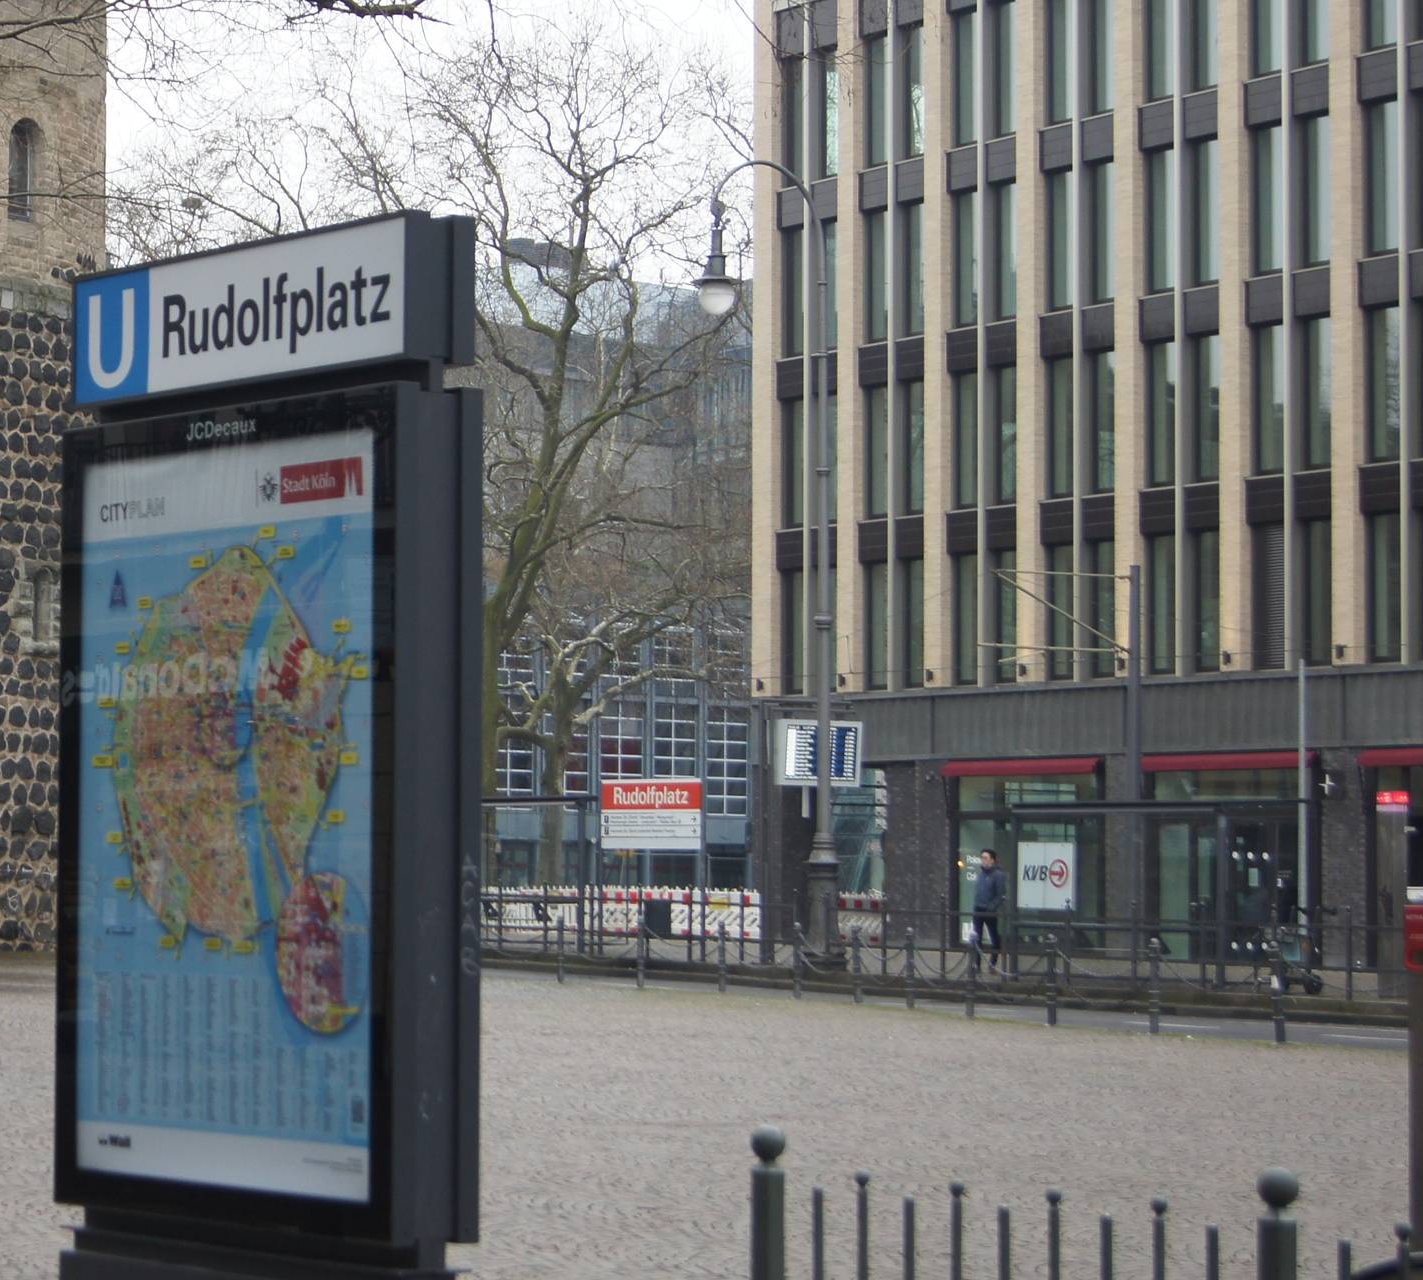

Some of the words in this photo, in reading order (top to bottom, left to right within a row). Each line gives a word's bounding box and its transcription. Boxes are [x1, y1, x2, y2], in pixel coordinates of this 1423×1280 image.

[88, 288, 135, 389] U
[162, 265, 391, 358] Rudolfplatz
[185, 418, 257, 441] JCDecaux
[282, 474, 310, 493] Stadt
[310, 471, 336, 489] Köln
[613, 785, 689, 809] Rudolfplatz
[1023, 865, 1048, 881] KVB
